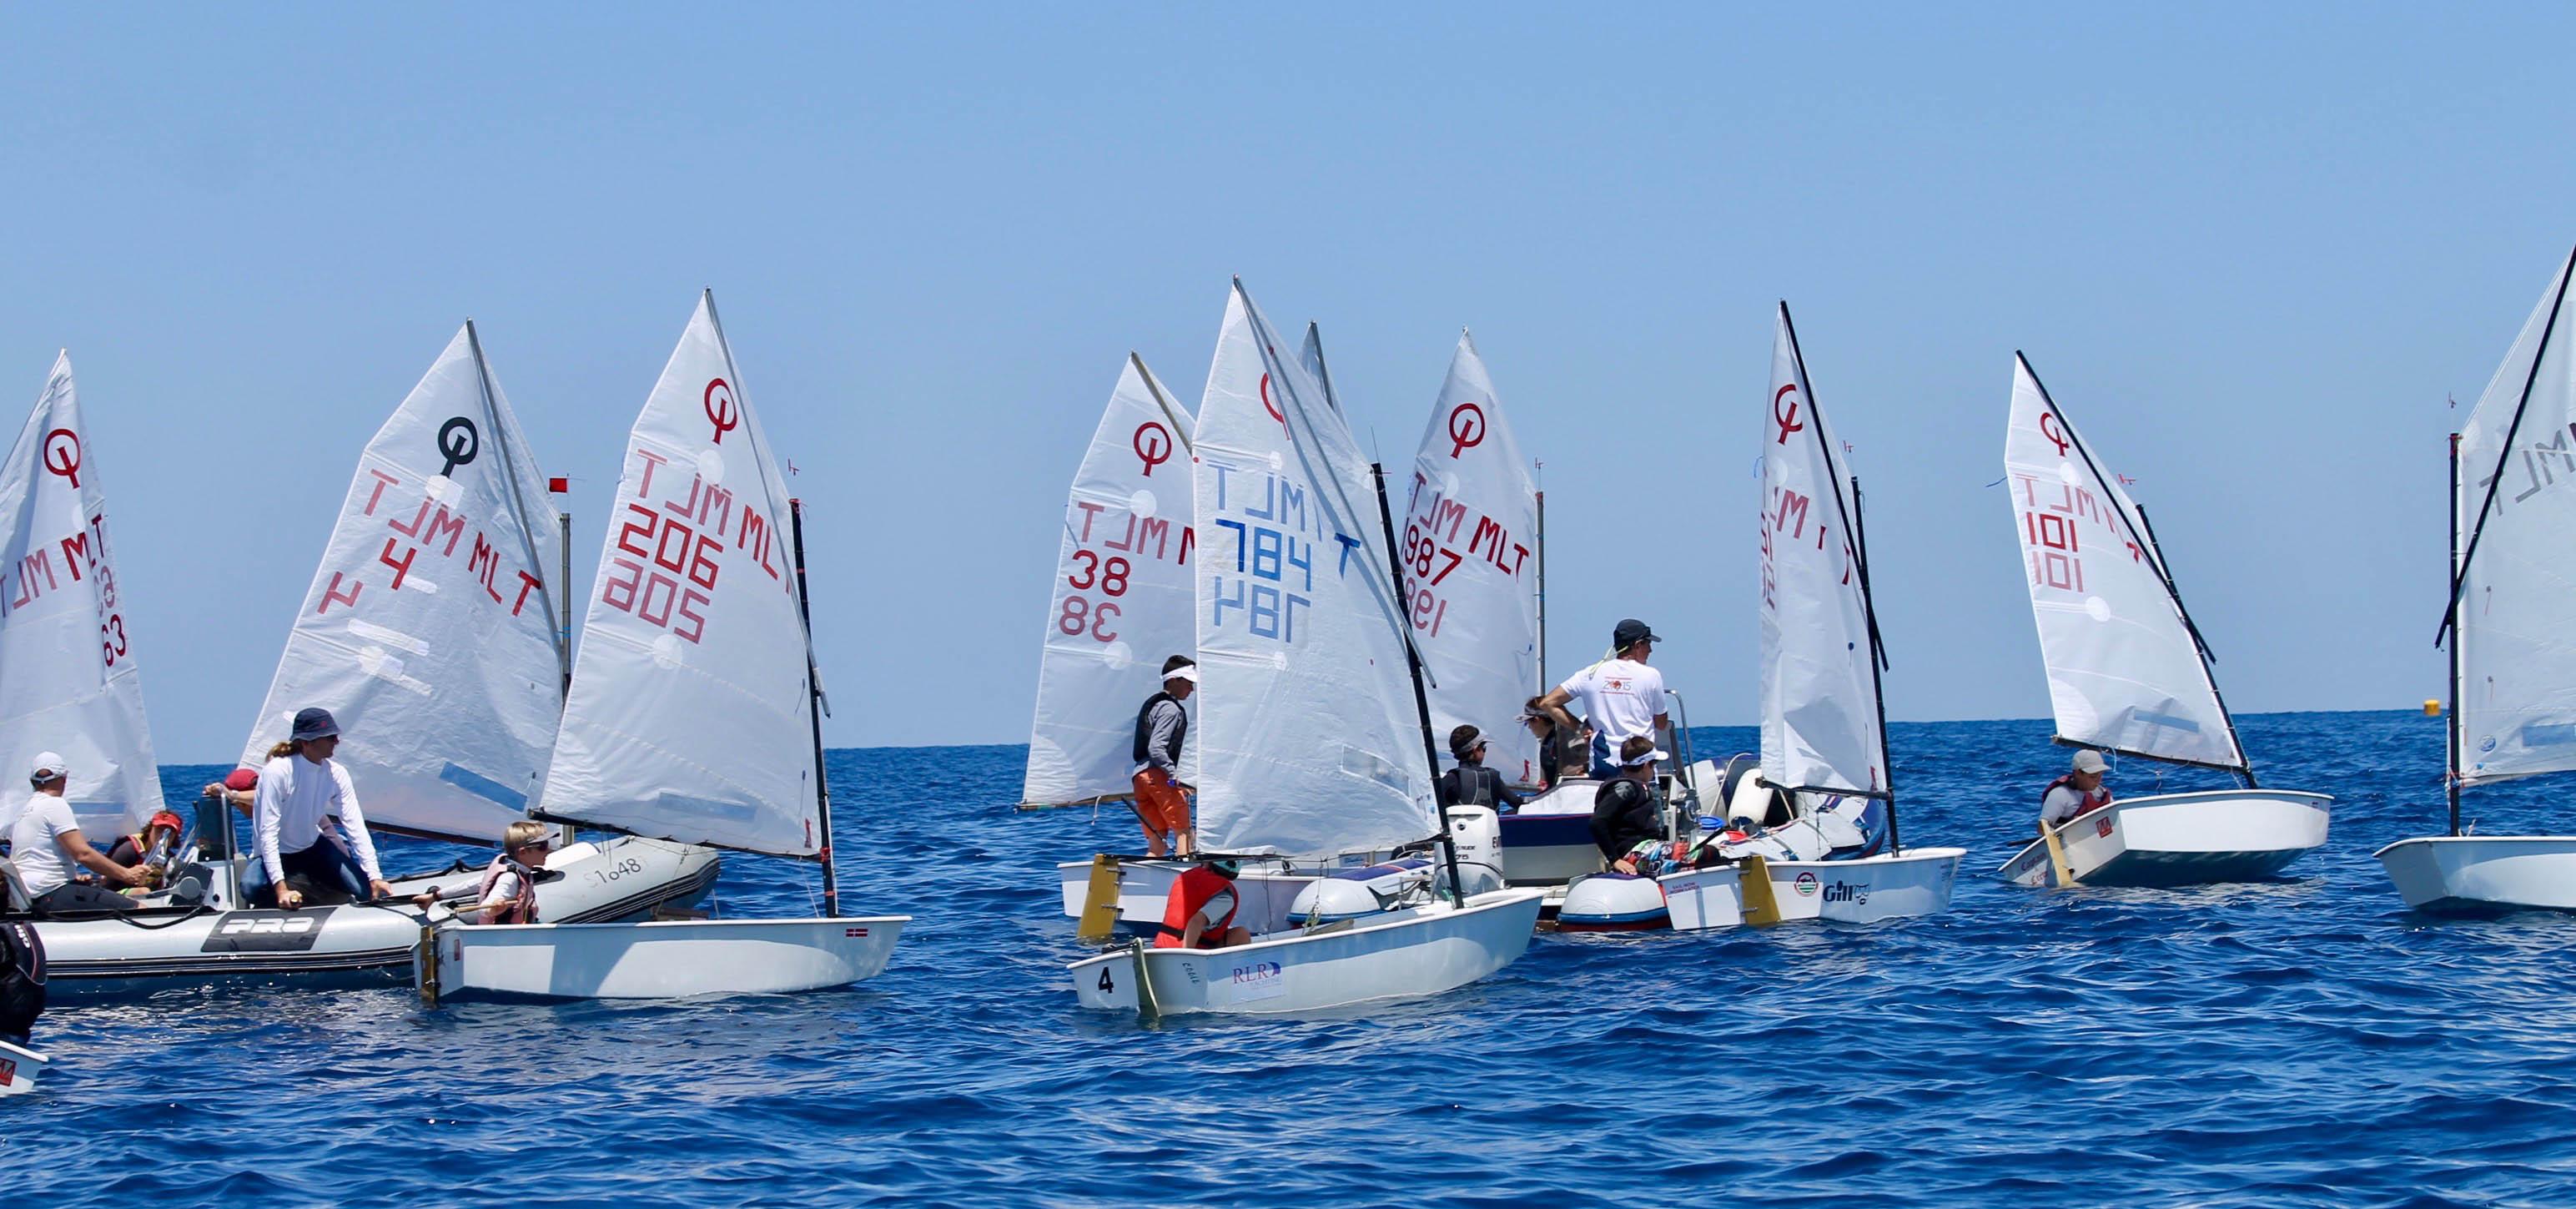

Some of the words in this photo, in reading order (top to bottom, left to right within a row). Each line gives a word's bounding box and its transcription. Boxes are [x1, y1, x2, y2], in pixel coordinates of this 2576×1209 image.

[618, 503, 724, 591] 206
[737, 504, 790, 595] ML
[1215, 518, 1311, 592] 784
[1468, 515, 1529, 583] MLT
[2026, 511, 2078, 552] 101
[380, 538, 417, 591] 4
[468, 531, 541, 617] MLT
[1069, 549, 1130, 597] 38
[102, 614, 126, 667] 63
[1823, 880, 1854, 902] Gill
[221, 917, 314, 934] PRO
[1098, 966, 1114, 994] 4
[1233, 963, 1268, 984] RLR
